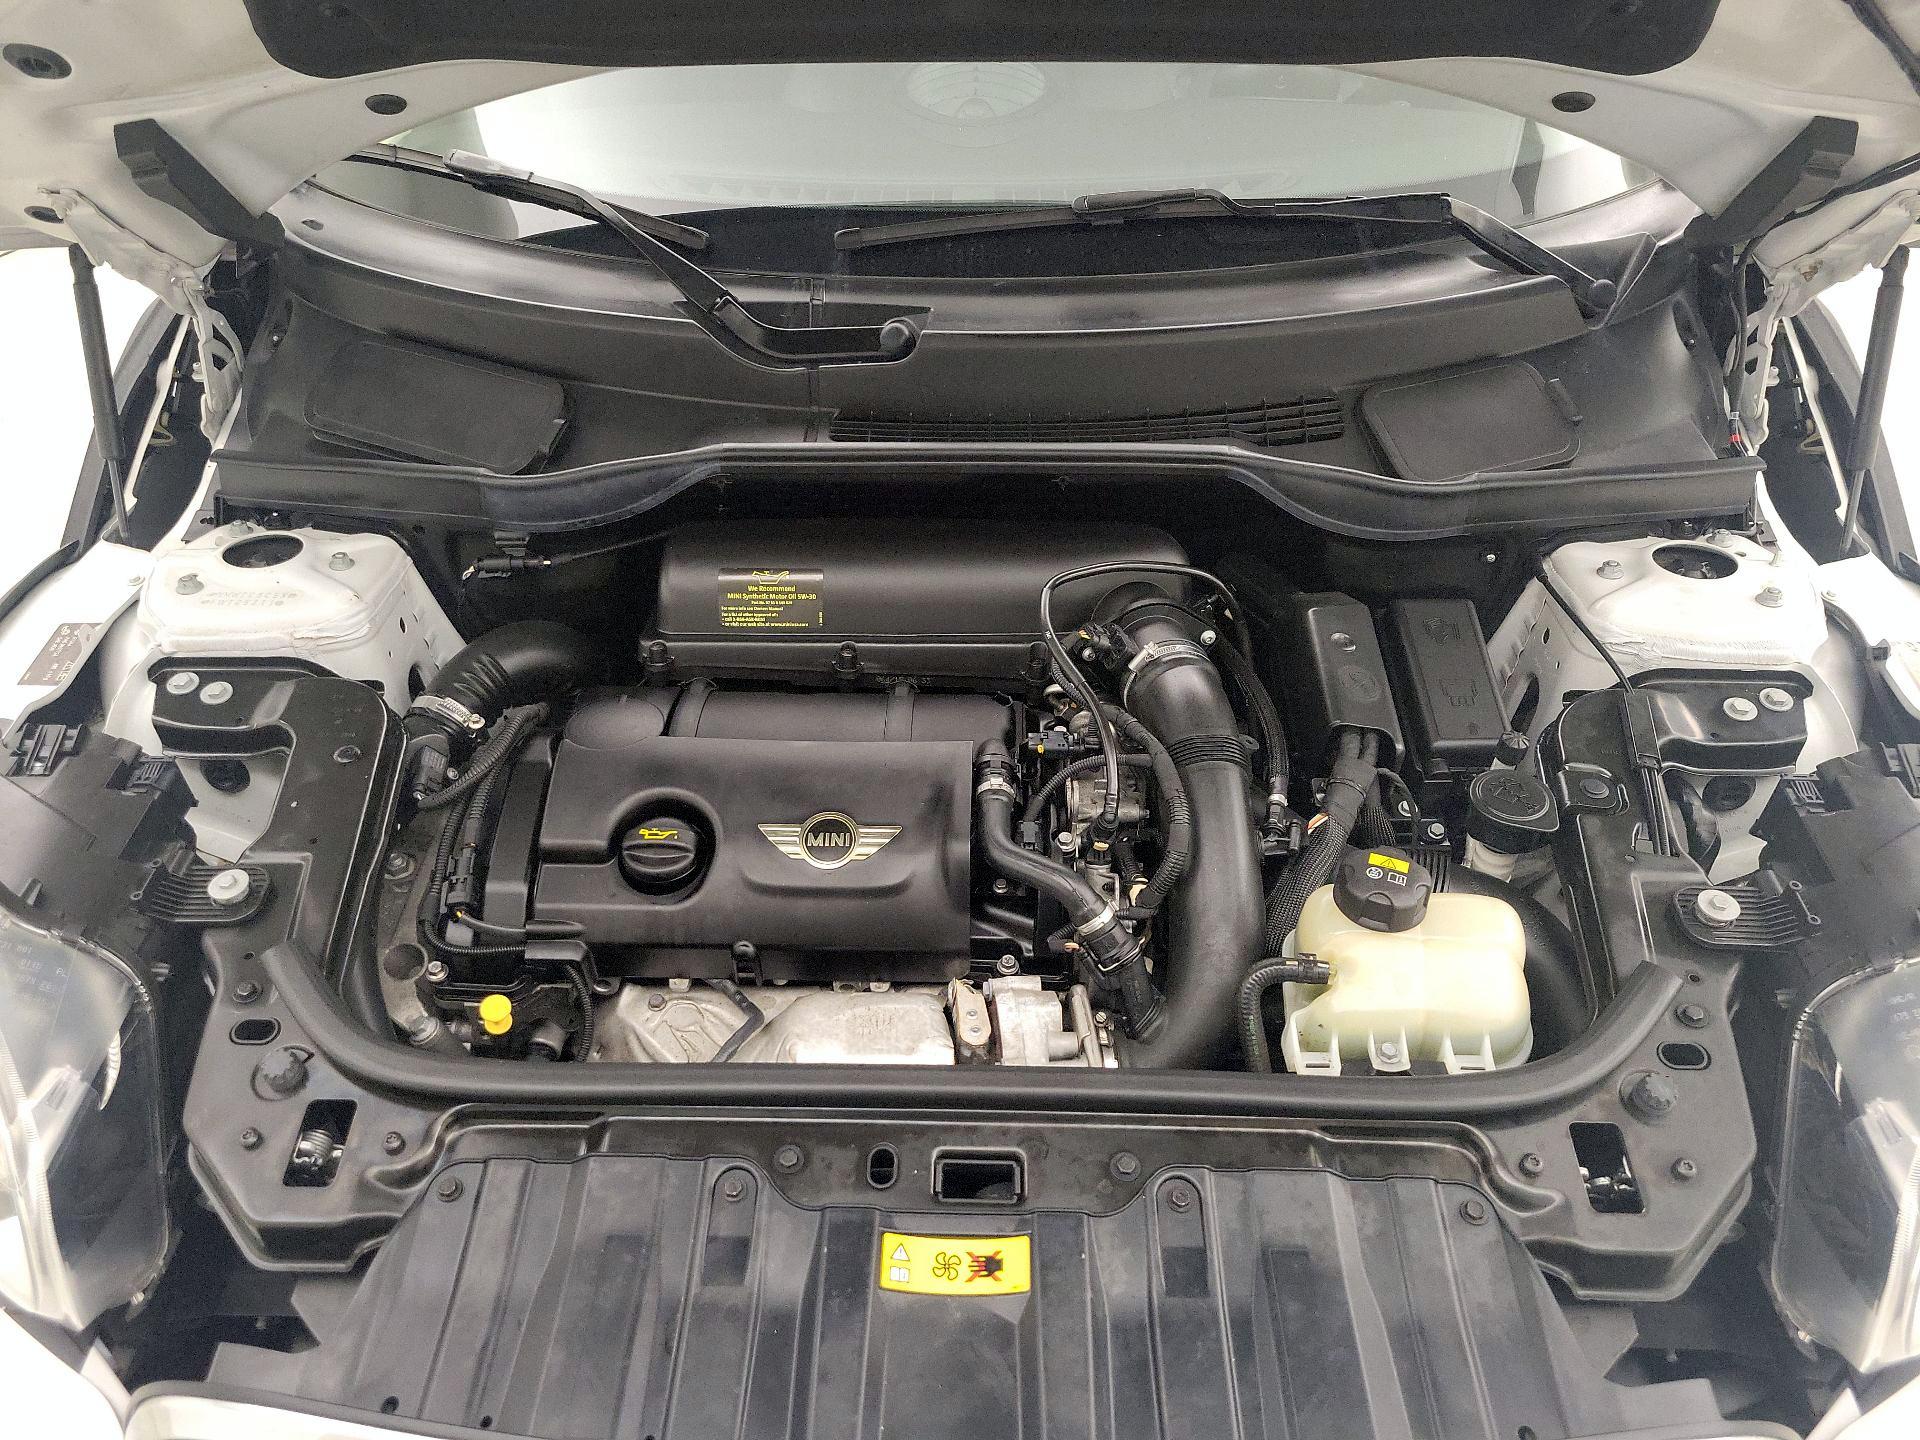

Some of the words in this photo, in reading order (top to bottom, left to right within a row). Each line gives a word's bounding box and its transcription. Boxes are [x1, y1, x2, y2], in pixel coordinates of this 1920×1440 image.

[727, 592, 742, 600] MINI
[742, 592, 769, 601] Synthetic
[807, 832, 851, 847] MINI
